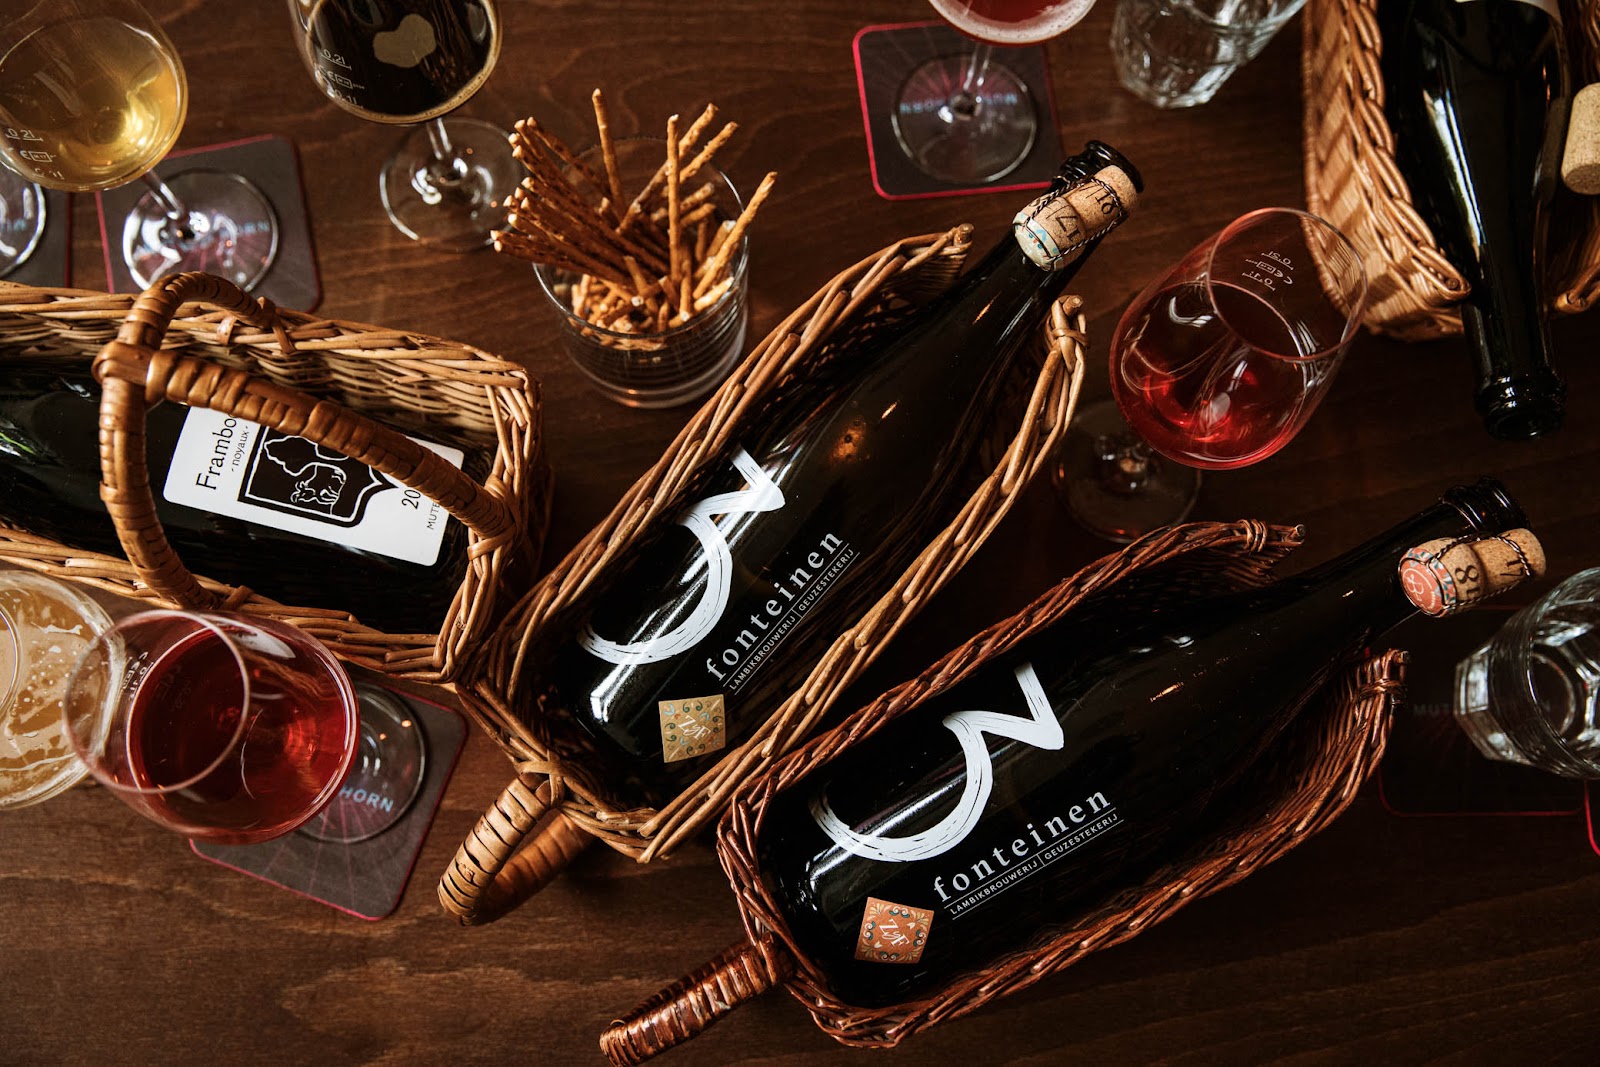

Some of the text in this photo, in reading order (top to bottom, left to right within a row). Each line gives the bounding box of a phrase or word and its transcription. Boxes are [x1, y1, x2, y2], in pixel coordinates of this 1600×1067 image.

[195, 413, 237, 491] Frambo
[705, 531, 844, 682] fonteinen
[729, 548, 855, 691] LAMBIKBROUWERIJ GEUZESTEKERIJ
[340, 784, 394, 813] HORN
[933, 791, 1111, 903] fonteinen
[950, 813, 1118, 915] LAMBIKBROUWERIJ GEUZESTEKERIJ
